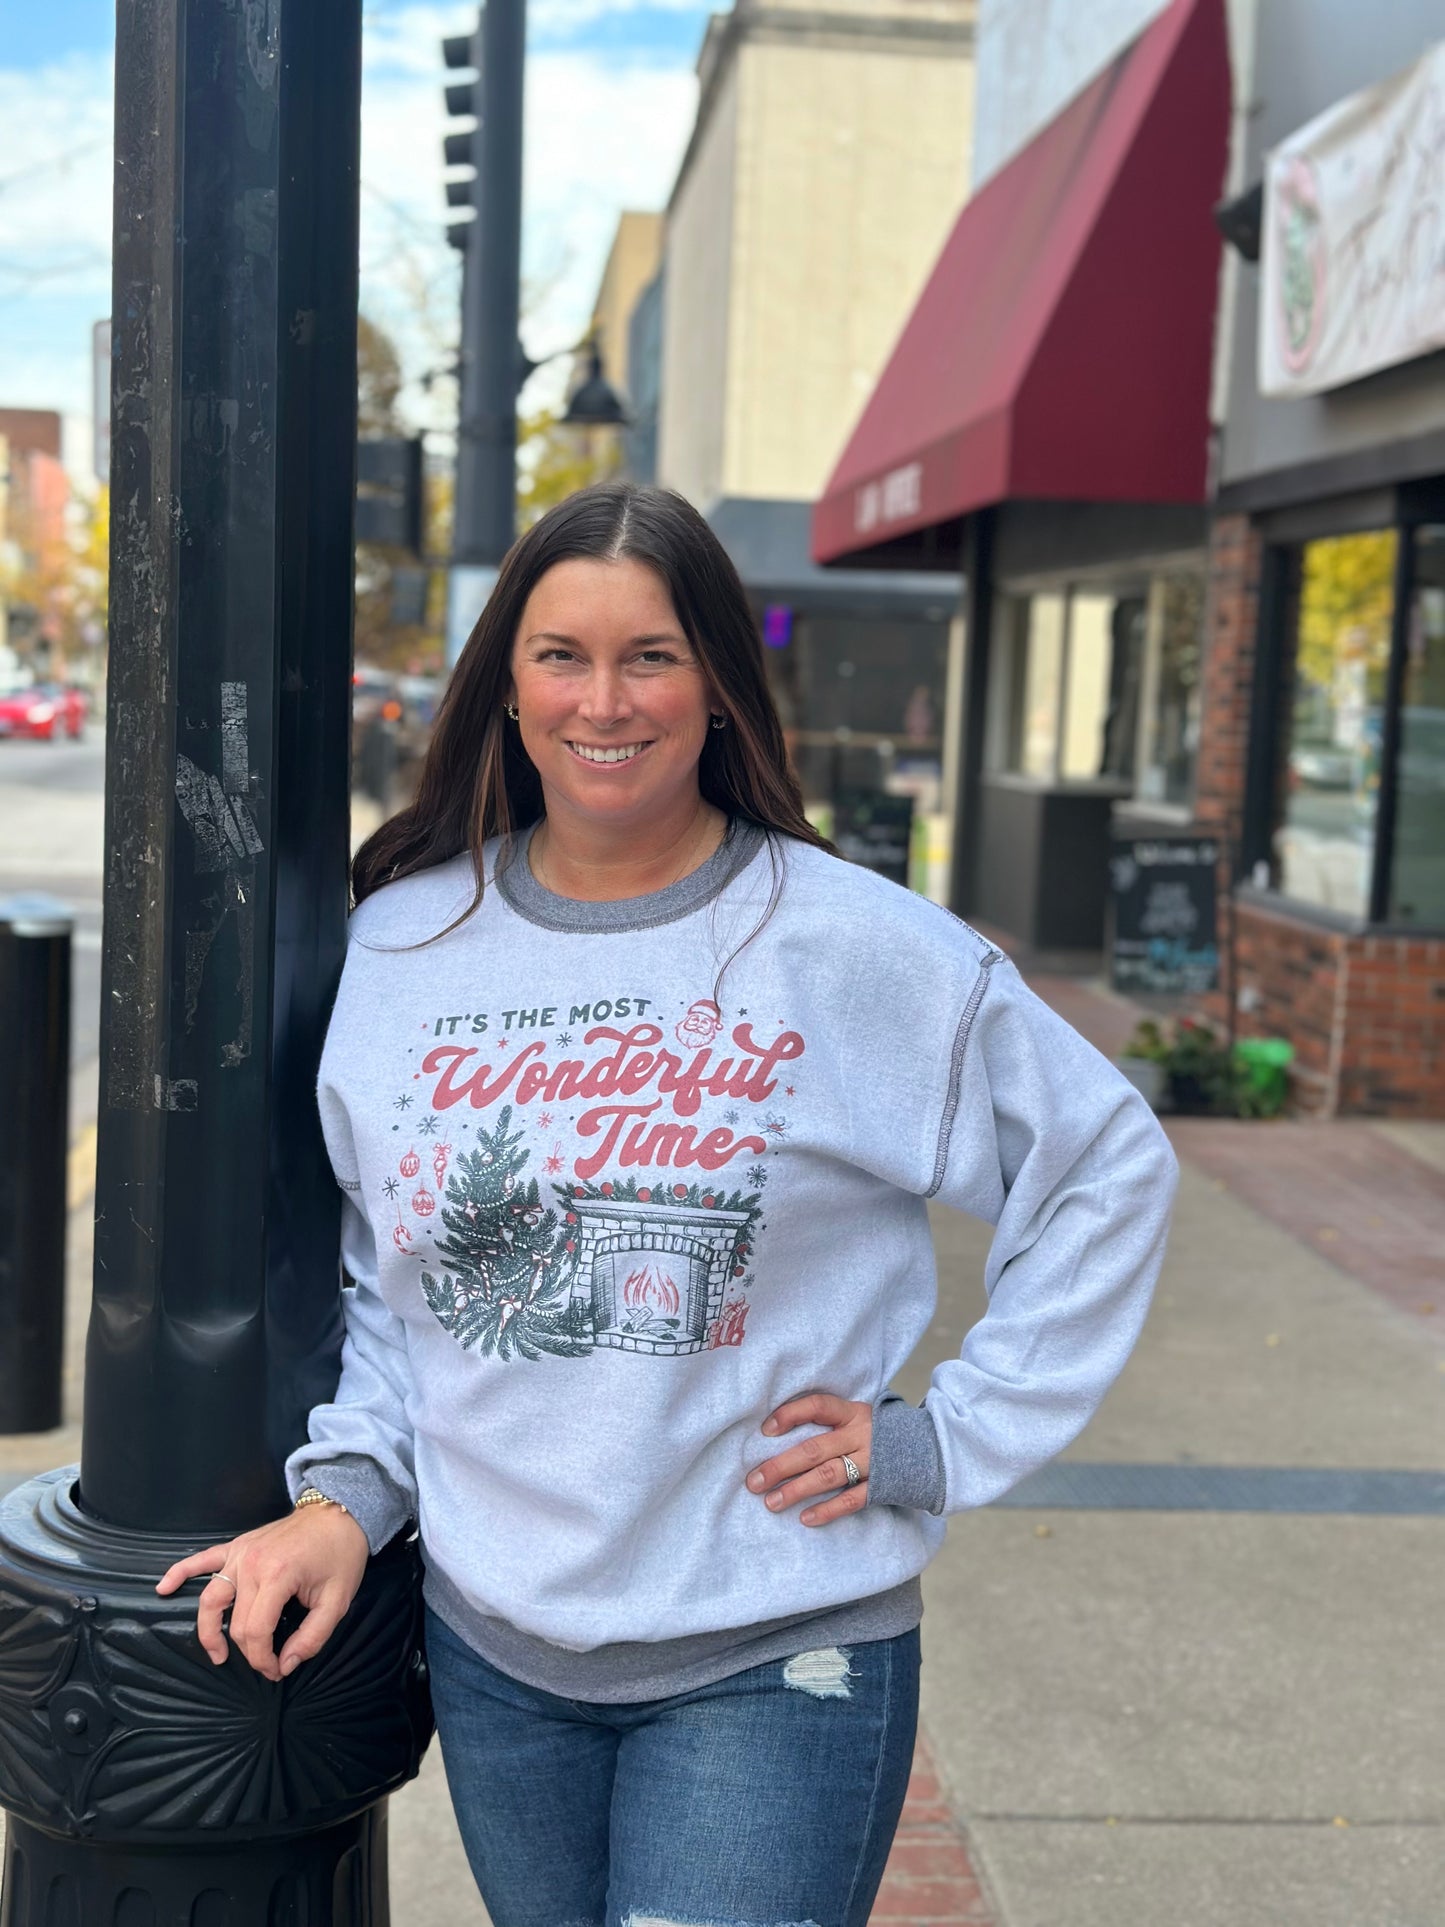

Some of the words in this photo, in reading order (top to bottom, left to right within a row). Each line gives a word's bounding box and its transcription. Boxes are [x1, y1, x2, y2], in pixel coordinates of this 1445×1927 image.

[434, 1014, 489, 1036] IT'S
[501, 1006, 557, 1029] THE
[568, 997, 652, 1026] MOST
[422, 1022, 806, 1117] Wonderful
[574, 1097, 767, 1180] Time
